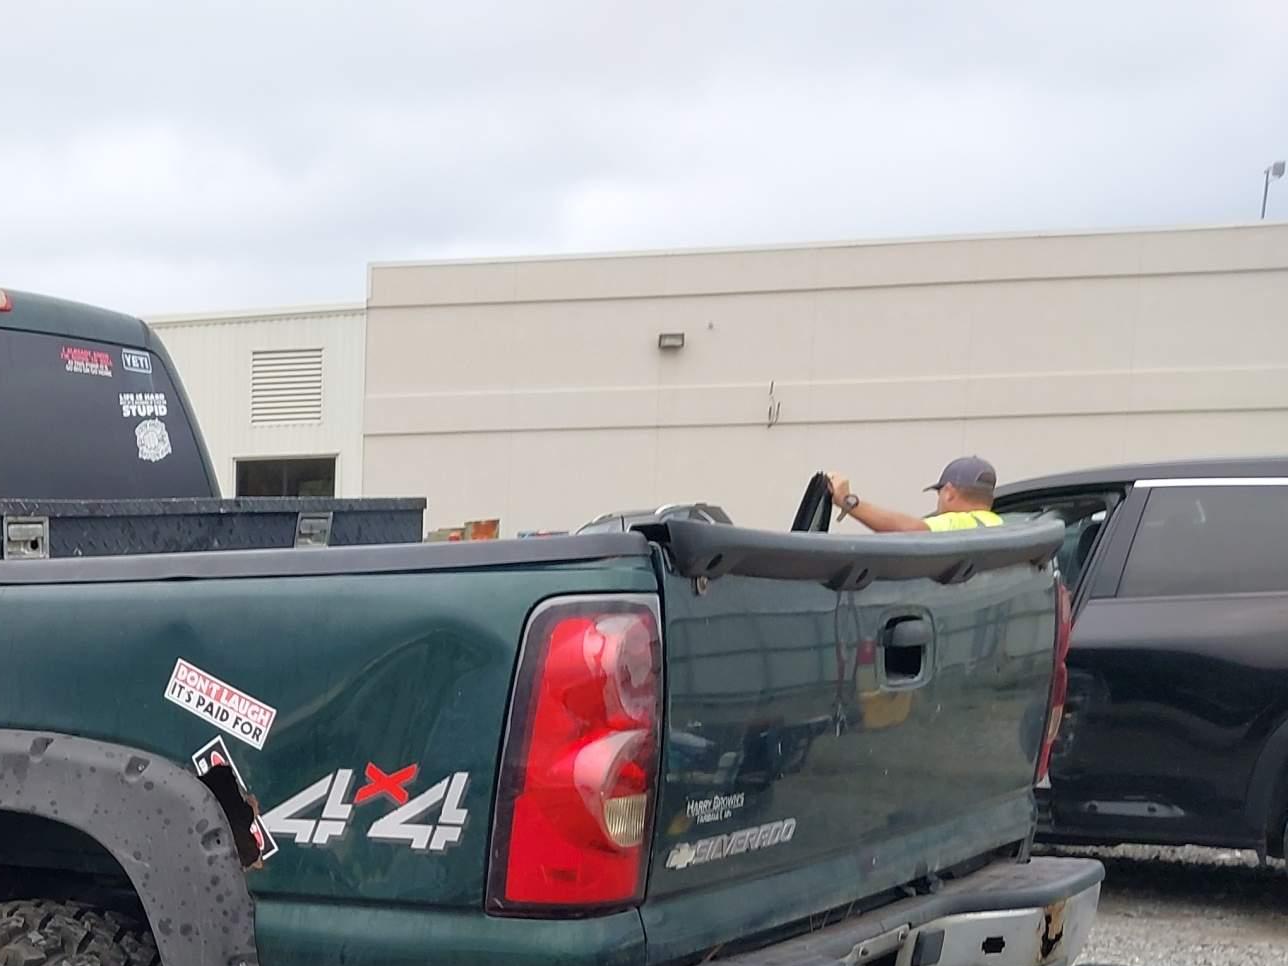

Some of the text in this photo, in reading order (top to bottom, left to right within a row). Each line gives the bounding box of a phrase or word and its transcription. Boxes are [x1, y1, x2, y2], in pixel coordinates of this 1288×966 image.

[124, 353, 149, 369] YETI
[122, 405, 168, 417] STUPID
[195, 695, 230, 722] PAID
[231, 716, 263, 742] FOR
[219, 688, 272, 727] LAUGH
[686, 799, 713, 817] HARRY
[692, 817, 797, 865] SILVERADO
